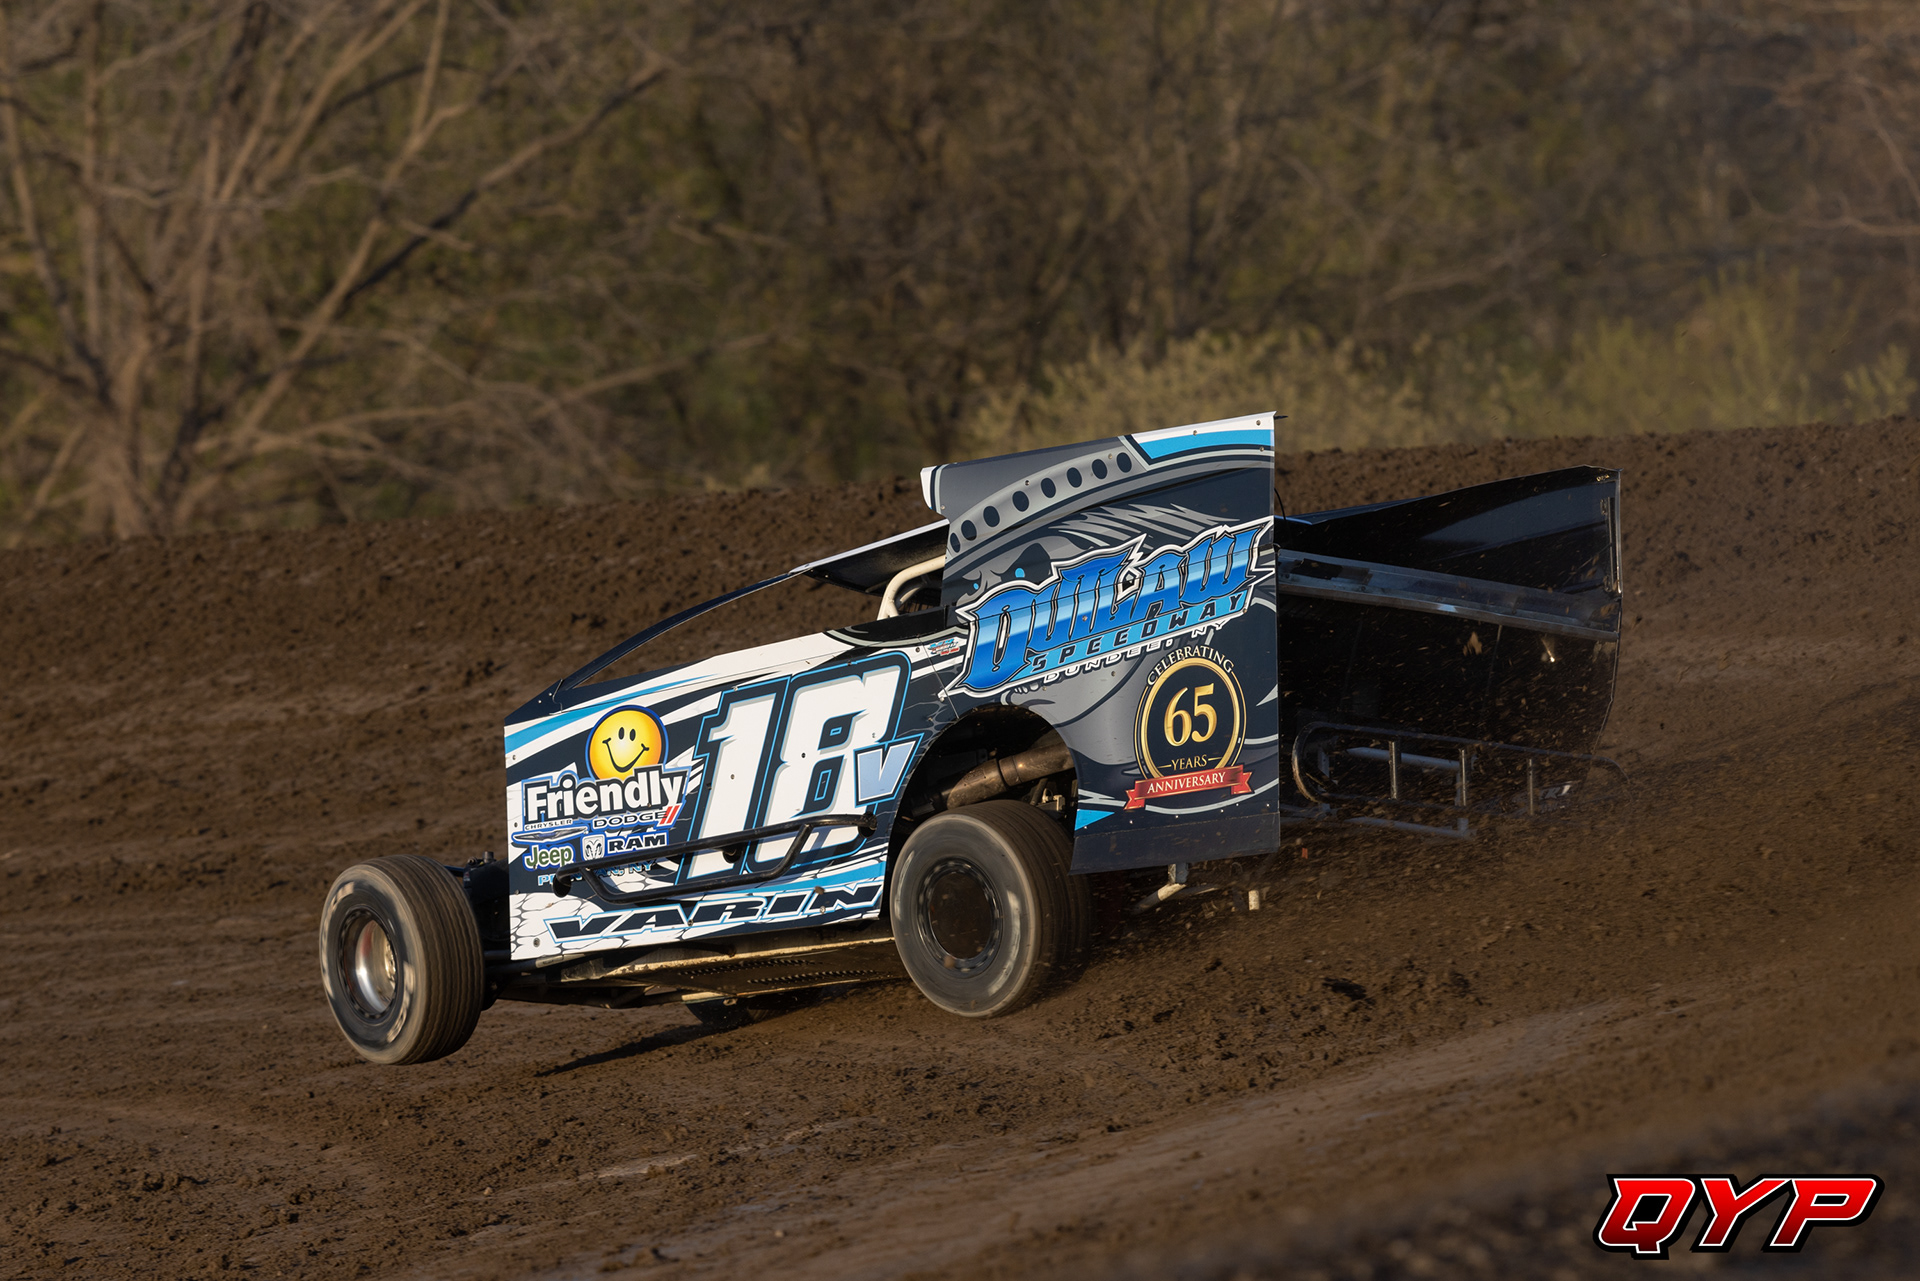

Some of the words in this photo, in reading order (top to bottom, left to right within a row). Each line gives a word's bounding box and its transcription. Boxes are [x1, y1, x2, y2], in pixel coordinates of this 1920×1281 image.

[960, 525, 1266, 690] OUTLAW
[1031, 592, 1245, 674] SPEEDWAY
[1190, 619, 1230, 639] NY
[1147, 645, 1235, 686] CELEBRATING
[1163, 682, 1218, 747] 65
[1171, 754, 1208, 771] YEARS
[1146, 771, 1227, 795] ANNIVERSARY
[523, 768, 688, 822] Friendly
[524, 818, 573, 831] CHRYSLER
[593, 810, 669, 828] DODGE
[608, 834, 667, 853] RAM
[525, 846, 574, 867] Jeep
[629, 860, 654, 875] NY
[547, 884, 883, 943] VARIN
